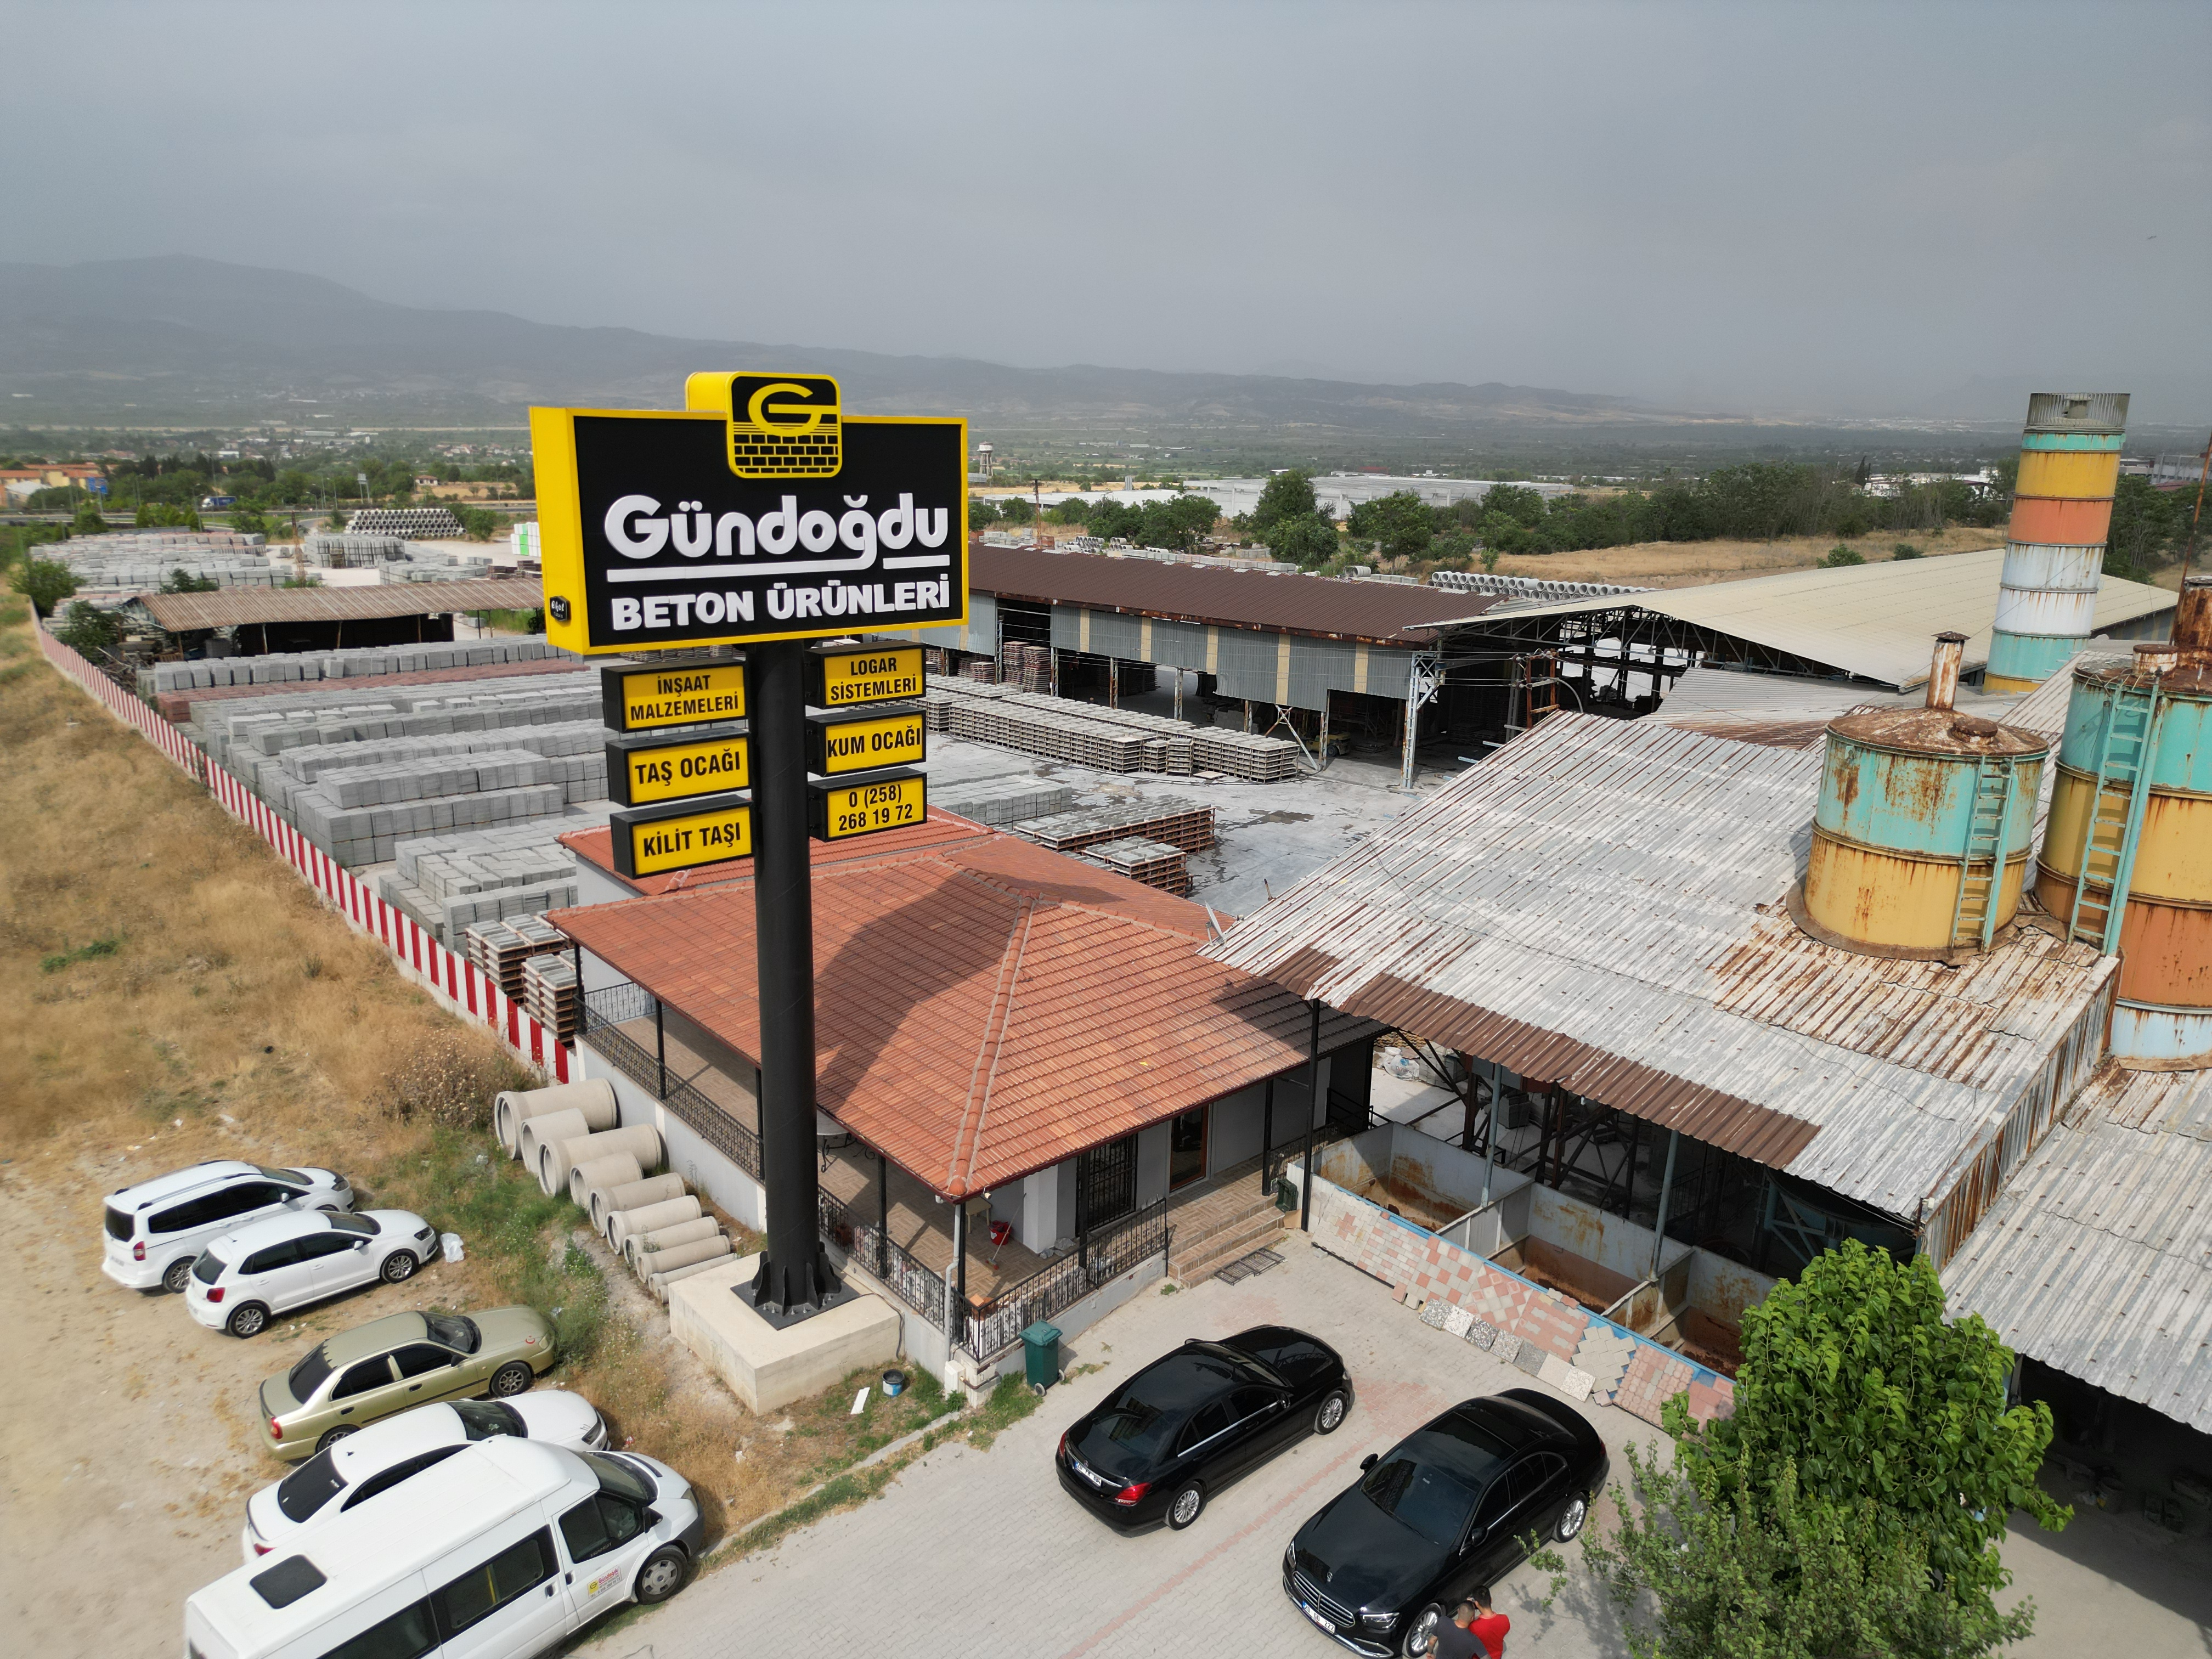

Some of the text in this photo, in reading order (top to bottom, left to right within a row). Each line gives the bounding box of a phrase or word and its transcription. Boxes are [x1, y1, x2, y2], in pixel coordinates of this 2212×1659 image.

[605, 493, 948, 571] Gündoğdu
[612, 573, 950, 630] BETON ÜRÜNLERİ
[850, 657, 898, 676] LOGAR
[657, 675, 711, 697] İNŞAAT
[830, 673, 917, 701] SİSTEMLERİ
[630, 691, 738, 721] MALZEMELERİ
[827, 724, 921, 758] KUM OCAĞI
[635, 748, 741, 787] TAŞ OCAĞI
[849, 784, 902, 809] 0 (258)
[838, 803, 913, 832] 268 19 72
[644, 822, 742, 857] KİLİT TAŞI
